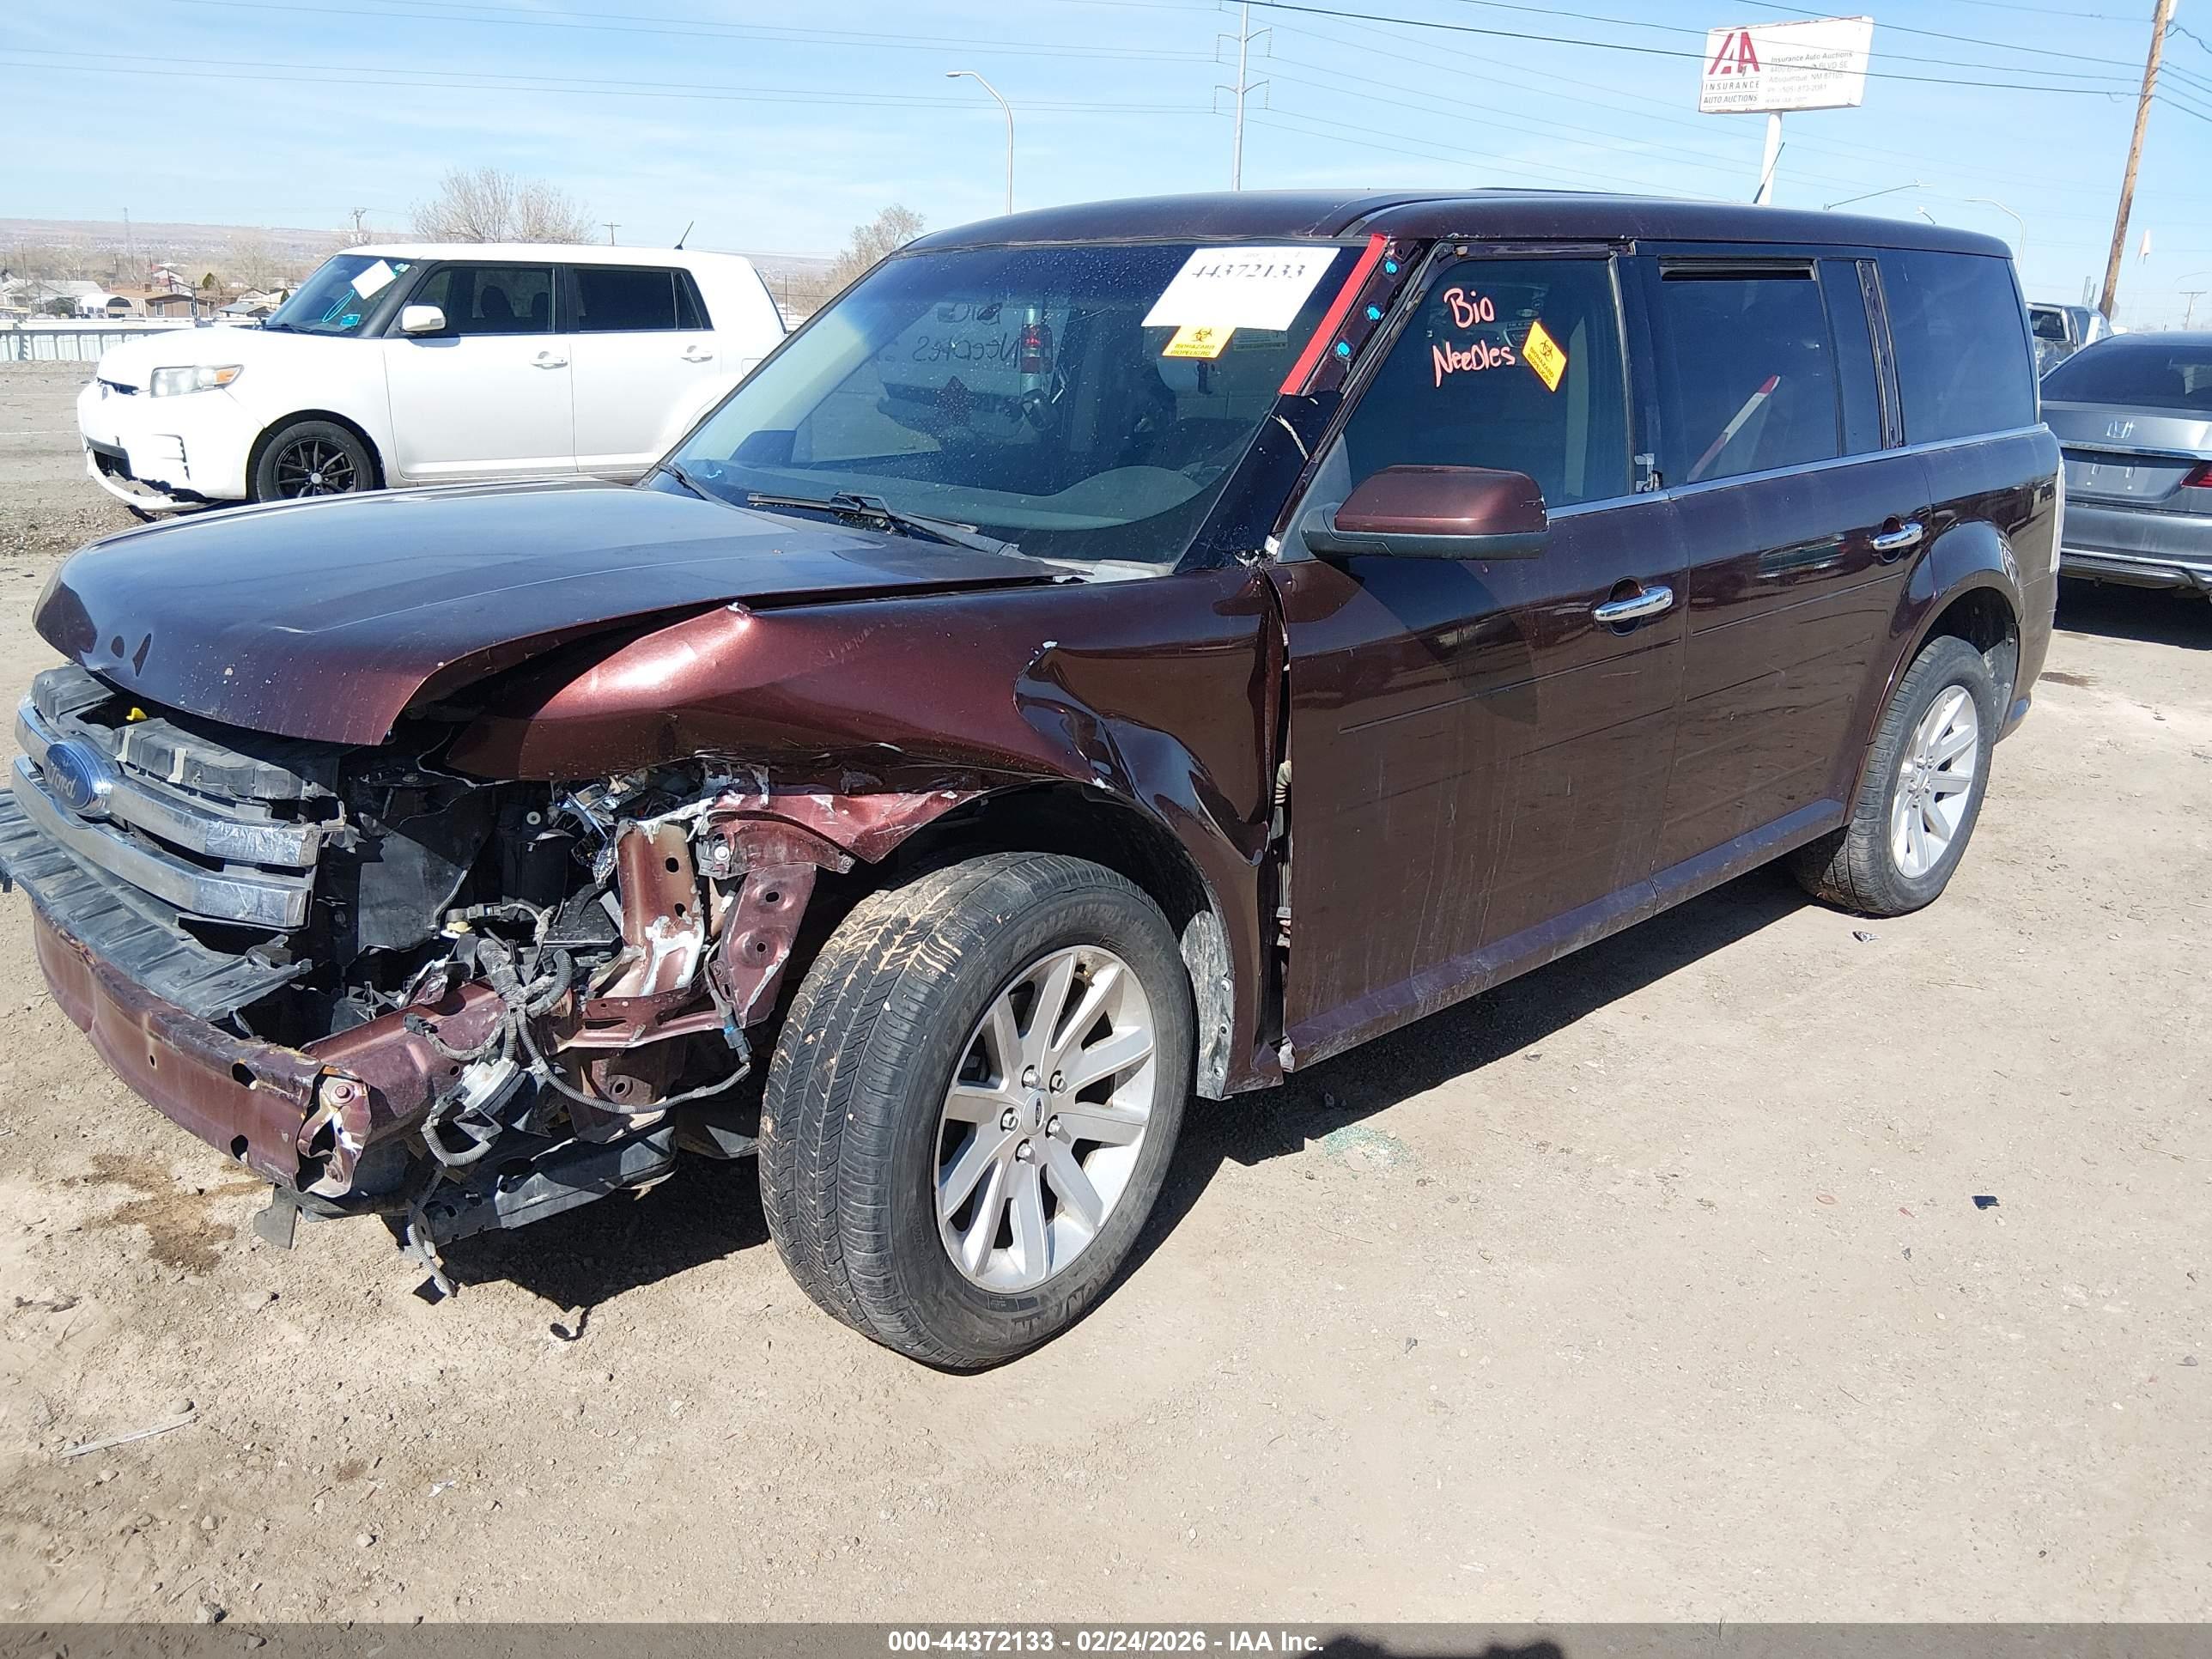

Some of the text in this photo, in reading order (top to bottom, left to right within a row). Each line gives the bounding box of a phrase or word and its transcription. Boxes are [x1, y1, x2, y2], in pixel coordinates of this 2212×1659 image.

[1705, 80, 1759, 91] INSURANCE
[1704, 95, 1723, 104] AUTO
[1723, 94, 1758, 103] AUCTIONS
[1192, 264, 1306, 278] 44372133
[1443, 288, 1495, 328] Bio
[1529, 347, 1554, 378] BIOHAZARD
